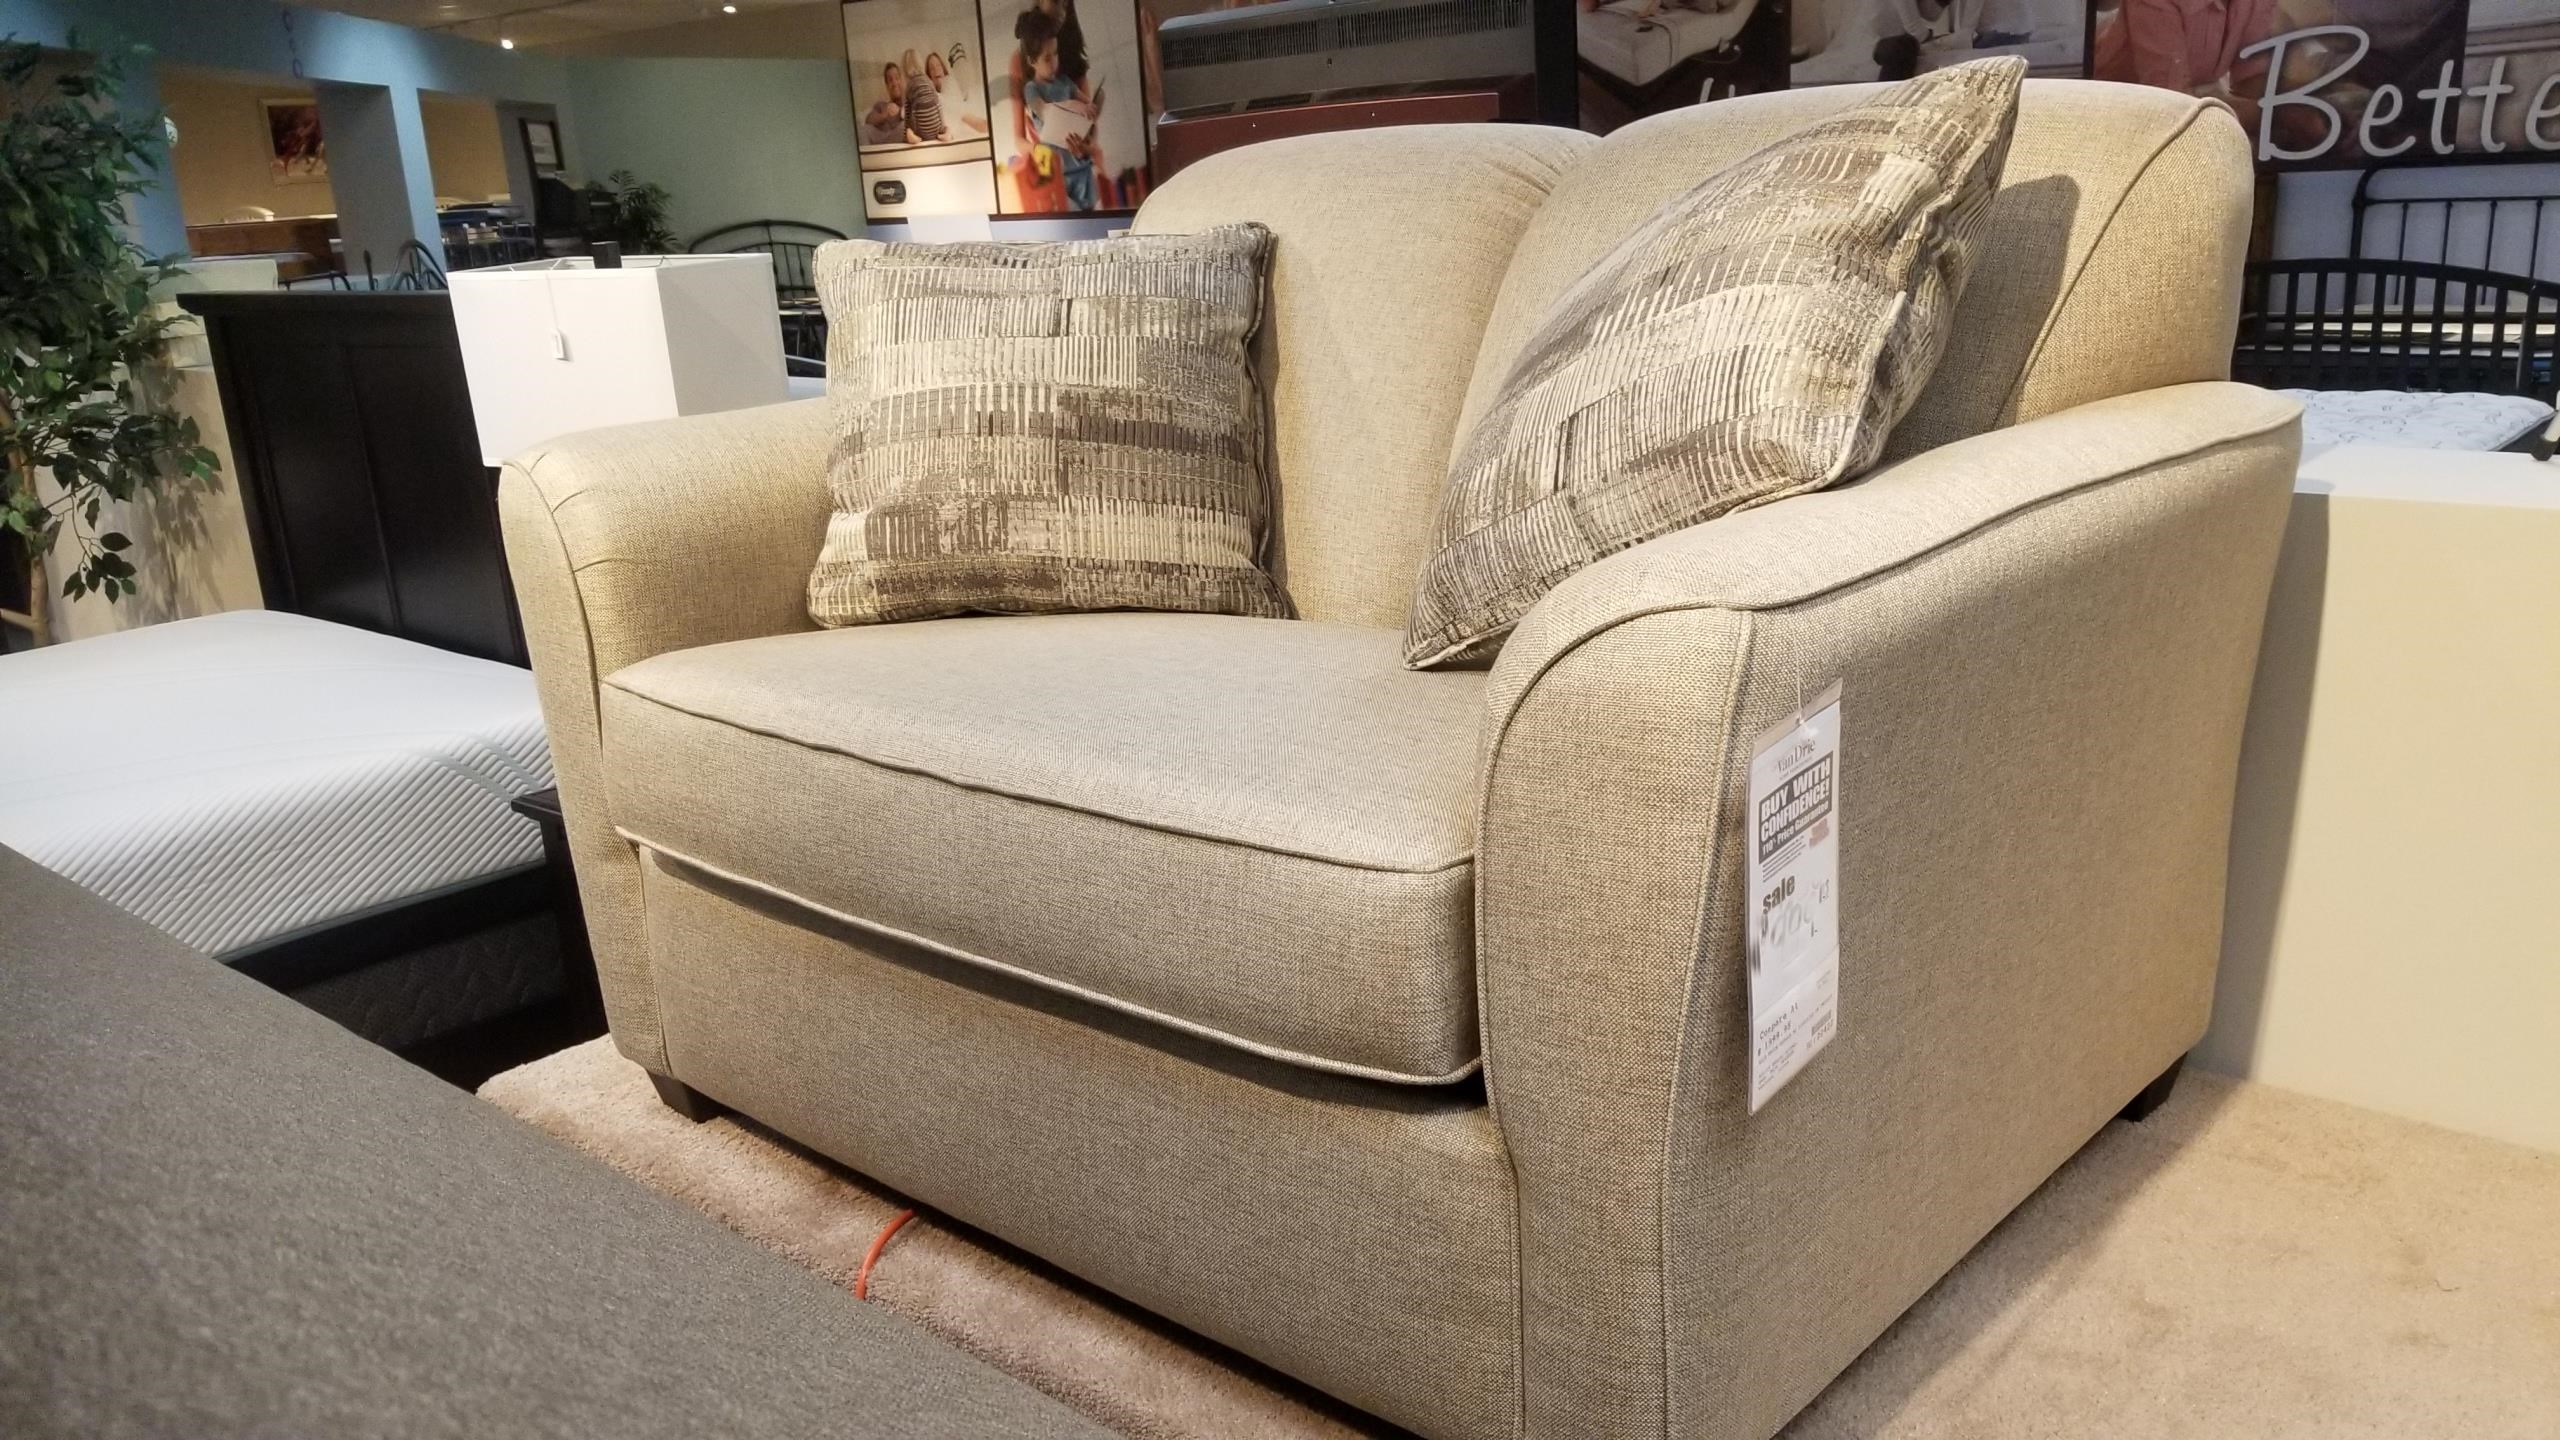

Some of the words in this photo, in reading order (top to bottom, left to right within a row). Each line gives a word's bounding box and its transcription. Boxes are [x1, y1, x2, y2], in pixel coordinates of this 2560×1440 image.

[1760, 778, 1830, 842] CONFIDENCE!
[1761, 785, 1789, 822] BUY
[1793, 757, 1831, 798] WITH
[1777, 825, 1795, 845] Price
[1762, 875, 1796, 914] sale
